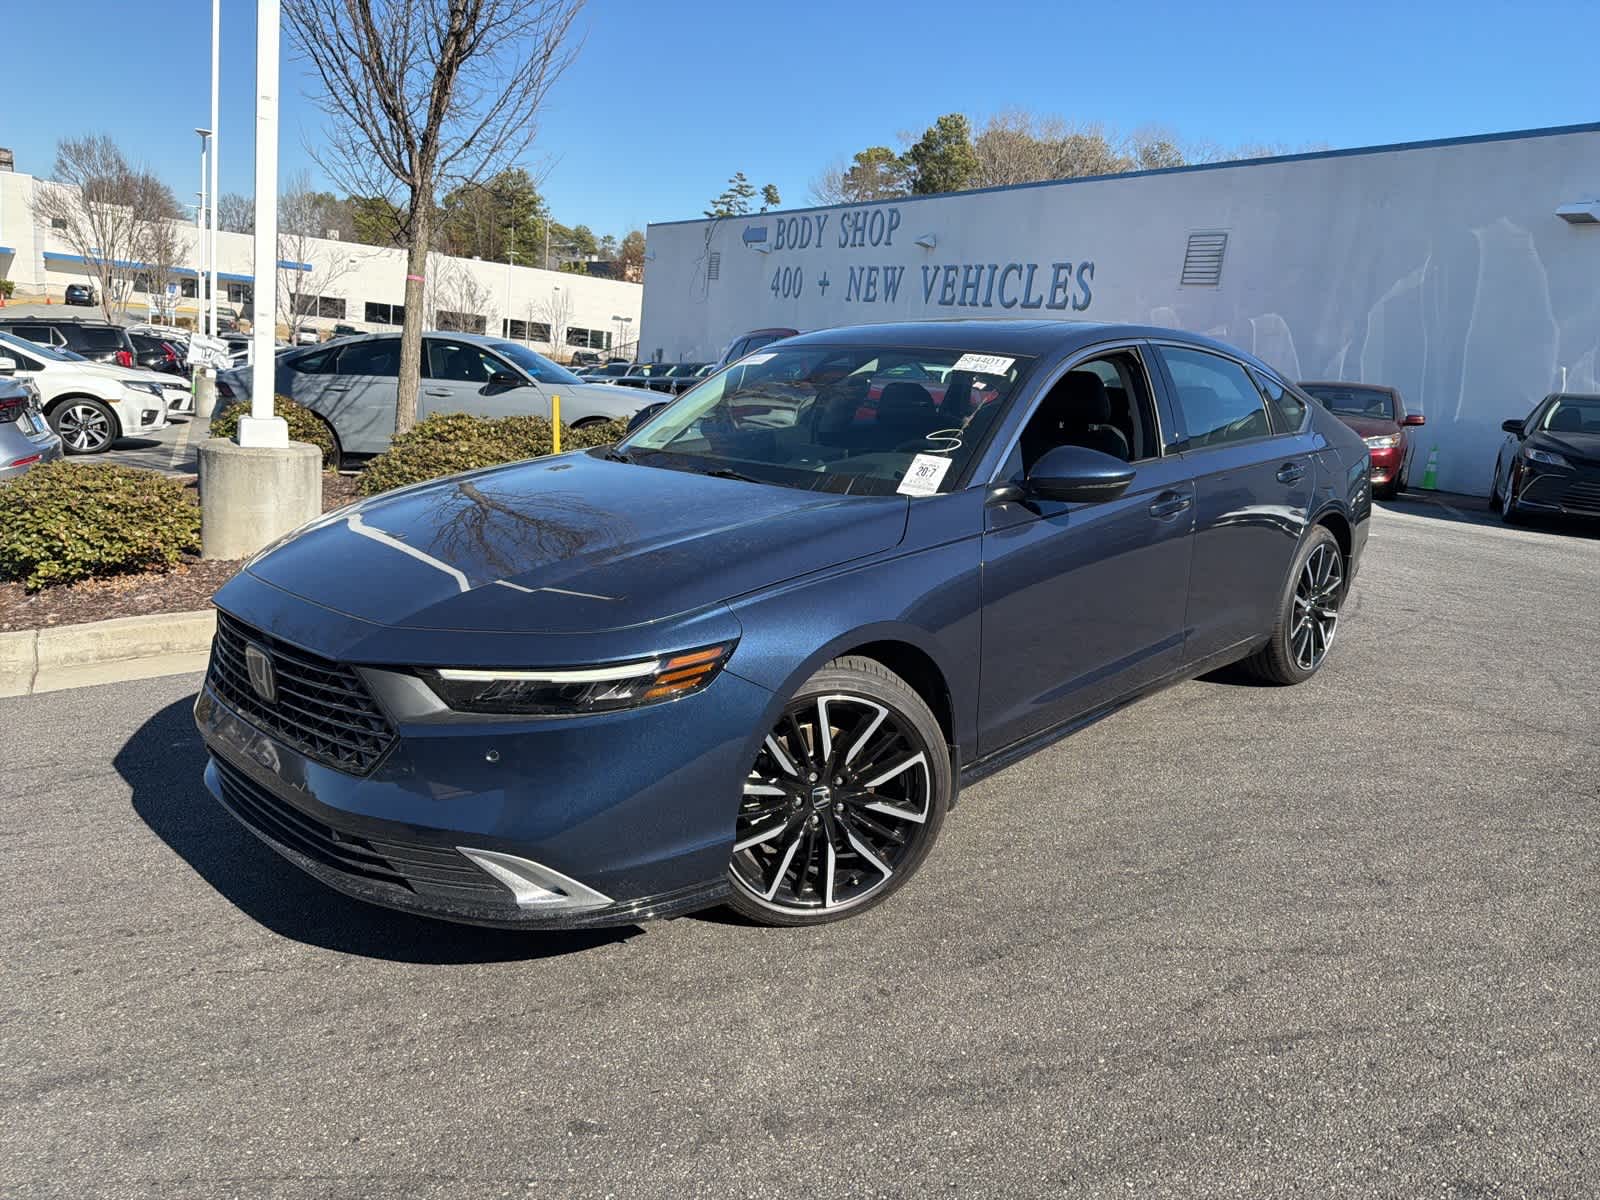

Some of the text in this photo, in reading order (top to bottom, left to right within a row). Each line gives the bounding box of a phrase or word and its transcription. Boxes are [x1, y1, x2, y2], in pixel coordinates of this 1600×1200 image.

[774, 207, 901, 250] BODY SHOP
[770, 266, 803, 299] 400
[845, 265, 905, 303] NEW
[921, 261, 1095, 312] VEHICLES
